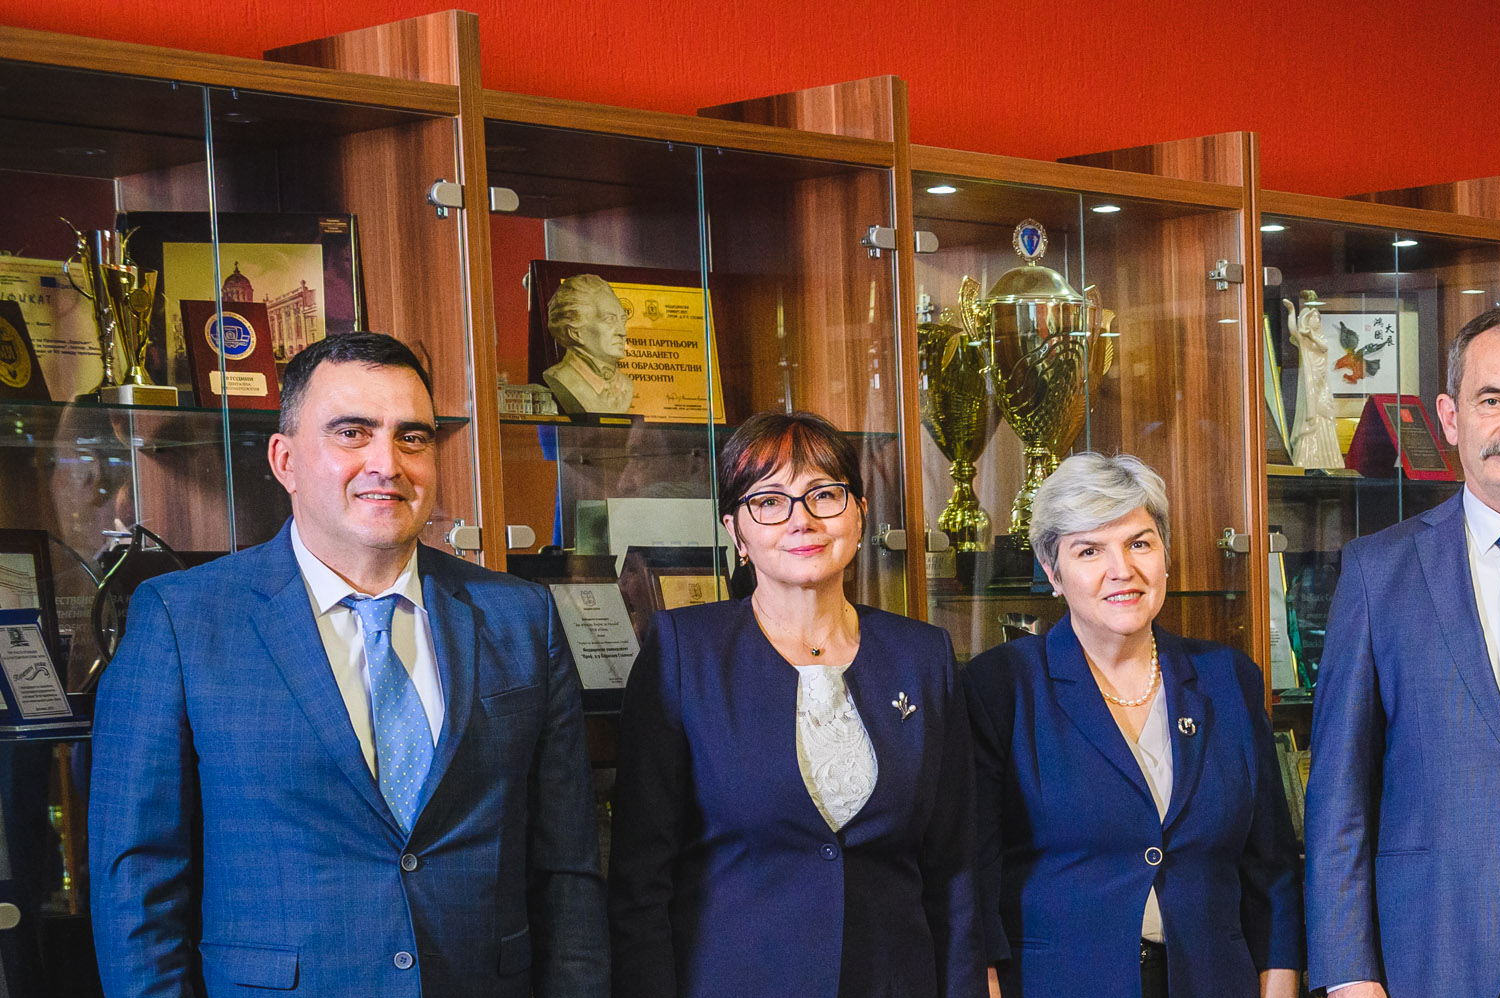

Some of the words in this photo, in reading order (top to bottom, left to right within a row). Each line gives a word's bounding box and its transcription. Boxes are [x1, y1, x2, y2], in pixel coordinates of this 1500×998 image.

[648, 338, 698, 348] ПАРТНЬОРИ
[632, 362, 702, 372] ОБРАЗОВАТЕЛНИ
[626, 373, 674, 382] ОРИЗОНТИ
